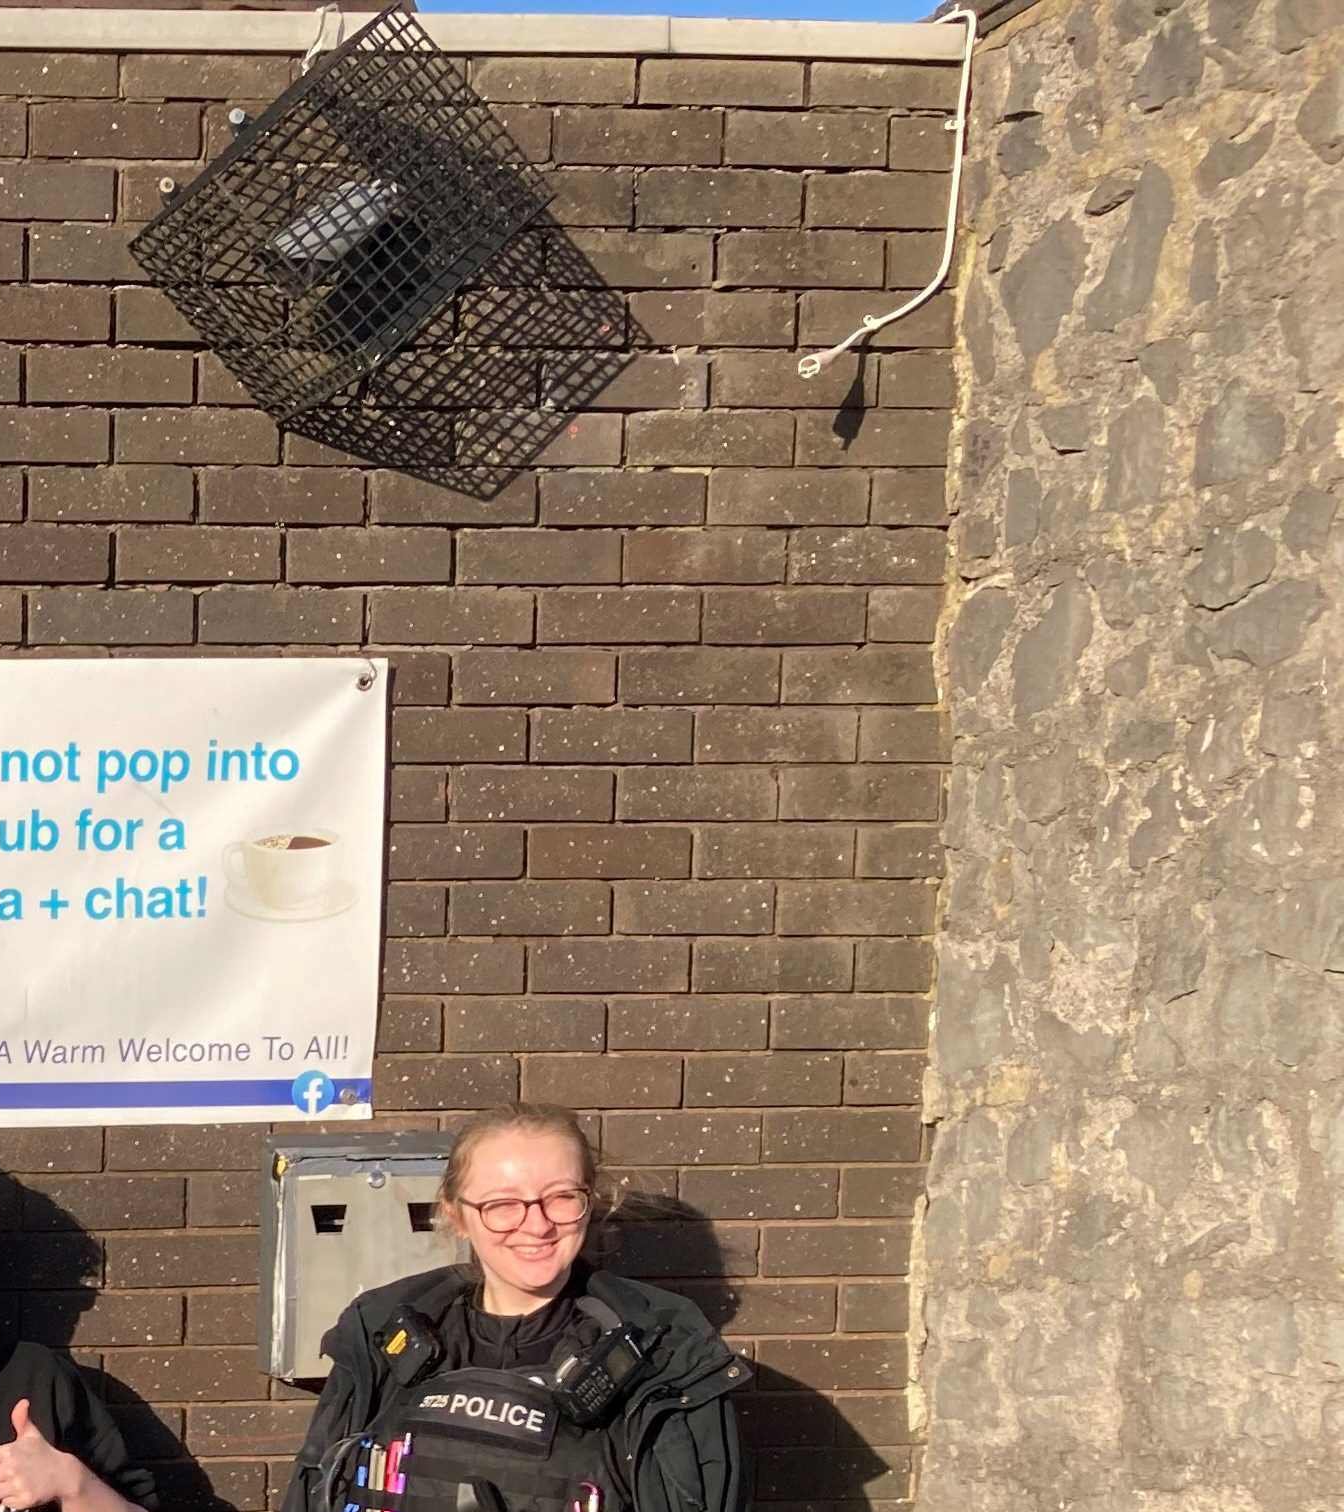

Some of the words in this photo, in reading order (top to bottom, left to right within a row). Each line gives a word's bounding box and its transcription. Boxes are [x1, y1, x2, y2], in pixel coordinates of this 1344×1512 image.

[0, 741, 81, 783] not
[97, 747, 190, 793] pop
[207, 739, 301, 782] into
[75, 808, 143, 851] for
[159, 818, 186, 850] a
[84, 876, 209, 919] chat!
[23, 1040, 106, 1064] Warm
[117, 1037, 251, 1063] Welcome
[263, 1035, 294, 1061] To
[304, 1034, 349, 1060] All!
[450, 1394, 545, 1432] POLICE
